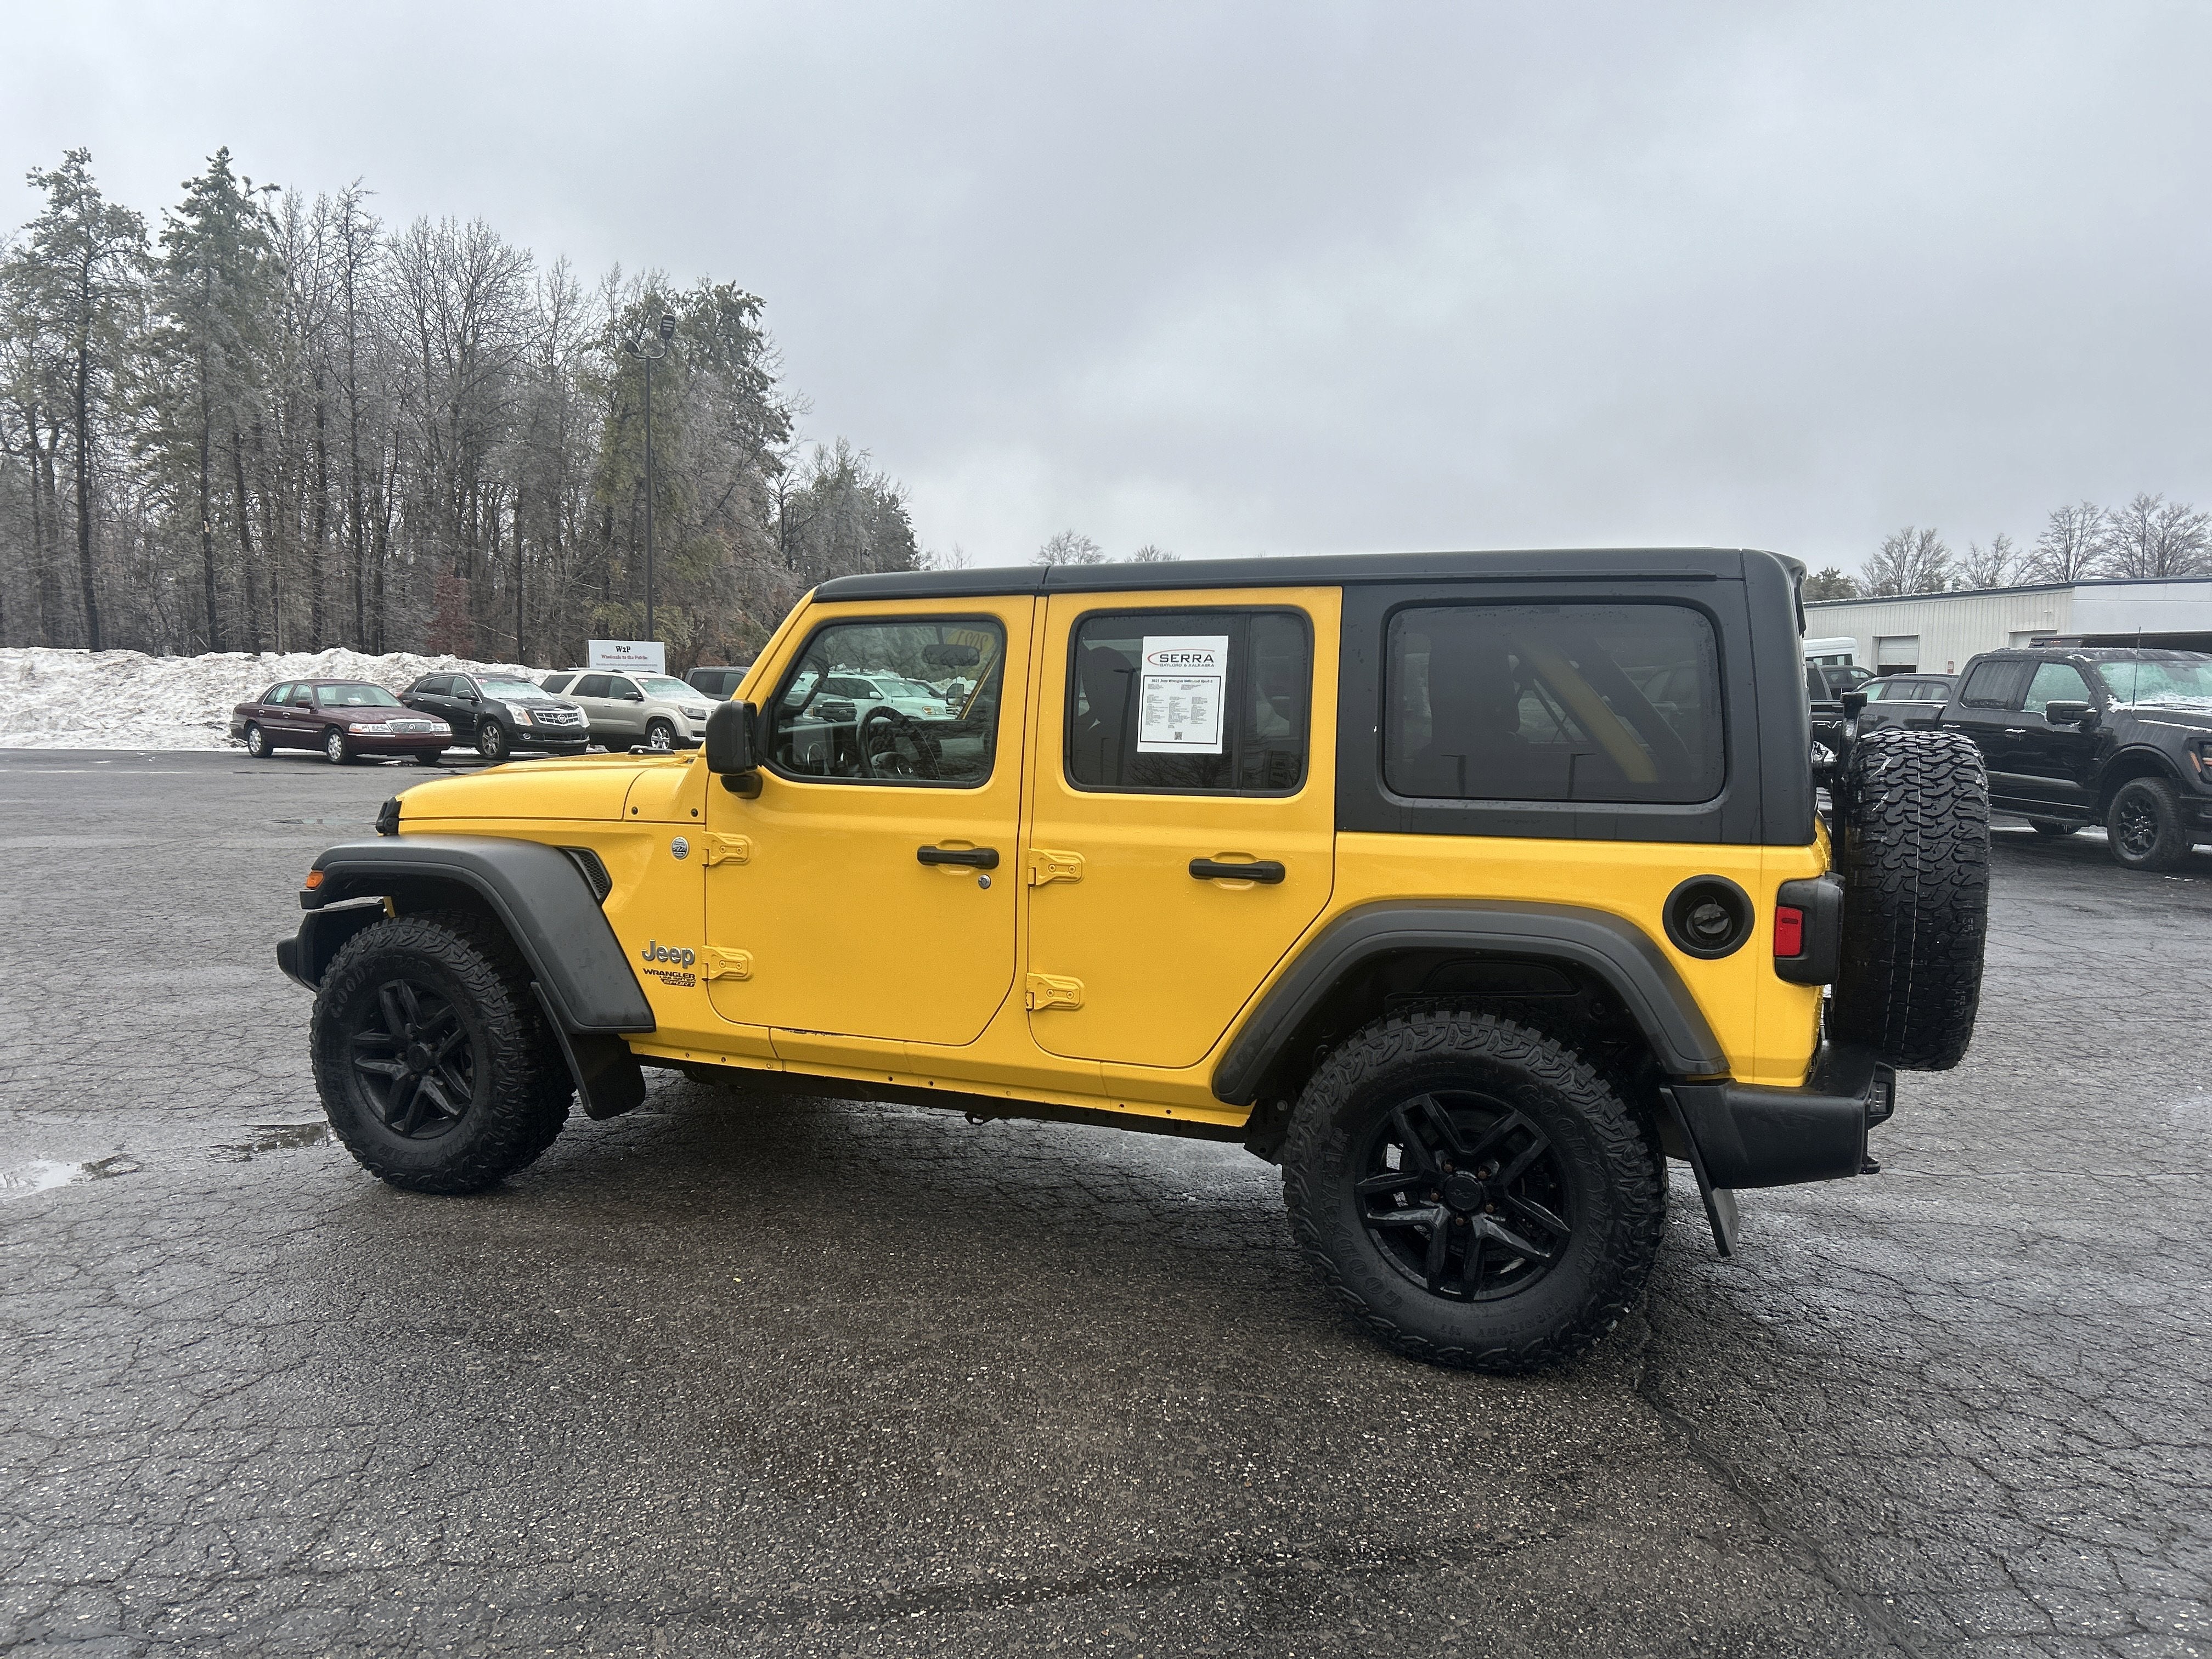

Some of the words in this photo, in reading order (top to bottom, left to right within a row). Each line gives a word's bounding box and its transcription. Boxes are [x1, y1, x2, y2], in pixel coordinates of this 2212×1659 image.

[1159, 654, 1214, 663] SERRA
[641, 939, 695, 969] Jeep
[642, 968, 696, 979] WRANGLER
